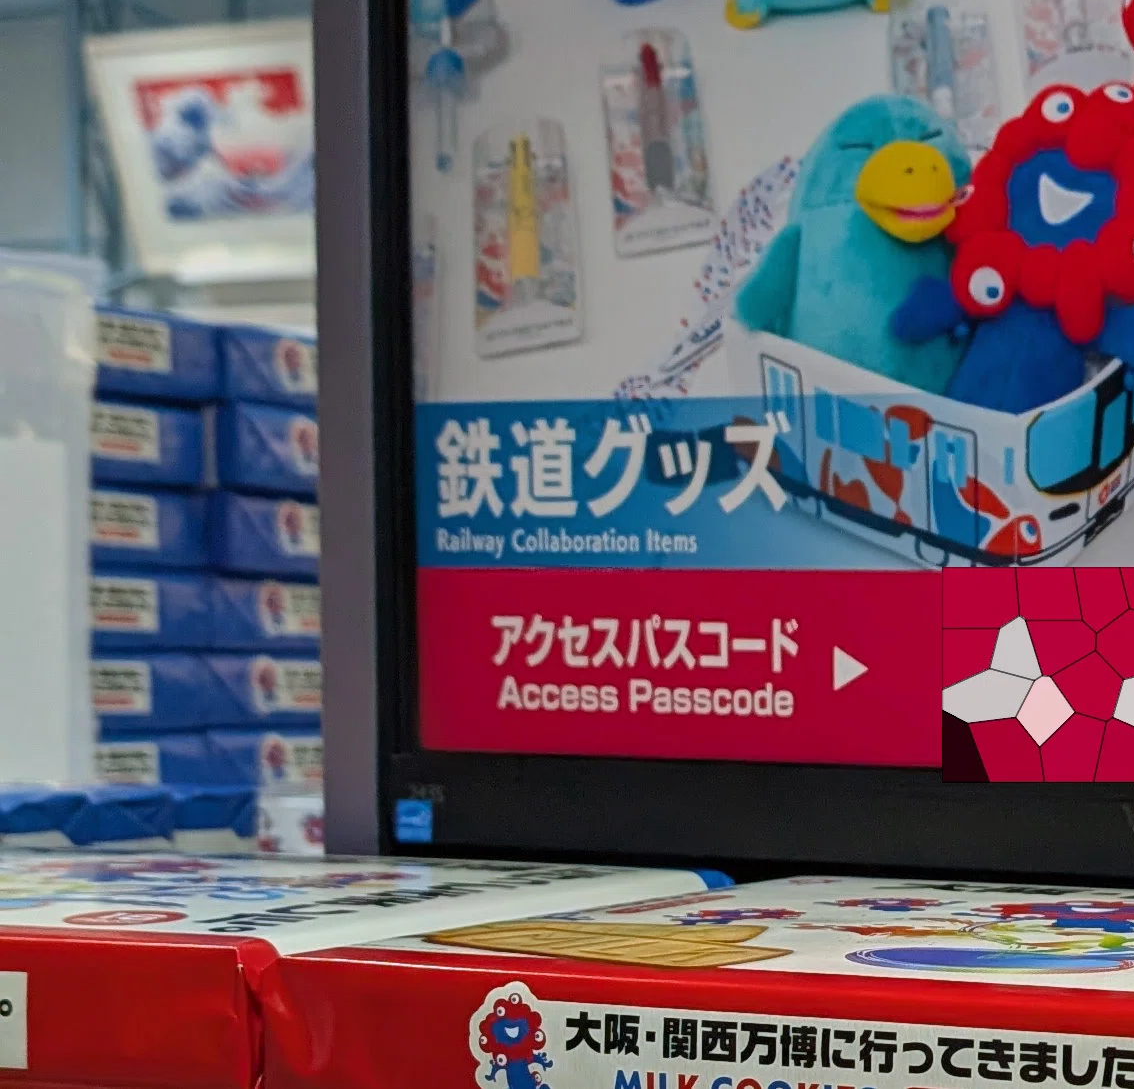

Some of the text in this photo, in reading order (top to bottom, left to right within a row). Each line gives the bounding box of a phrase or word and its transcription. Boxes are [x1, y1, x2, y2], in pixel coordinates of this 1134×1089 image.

[435, 411, 792, 519] 鉄道グッズ
[435, 527, 698, 558] Railway Collaboration Items
[491, 614, 800, 674] アクセスパスコード
[497, 676, 795, 718] Access Passcode
